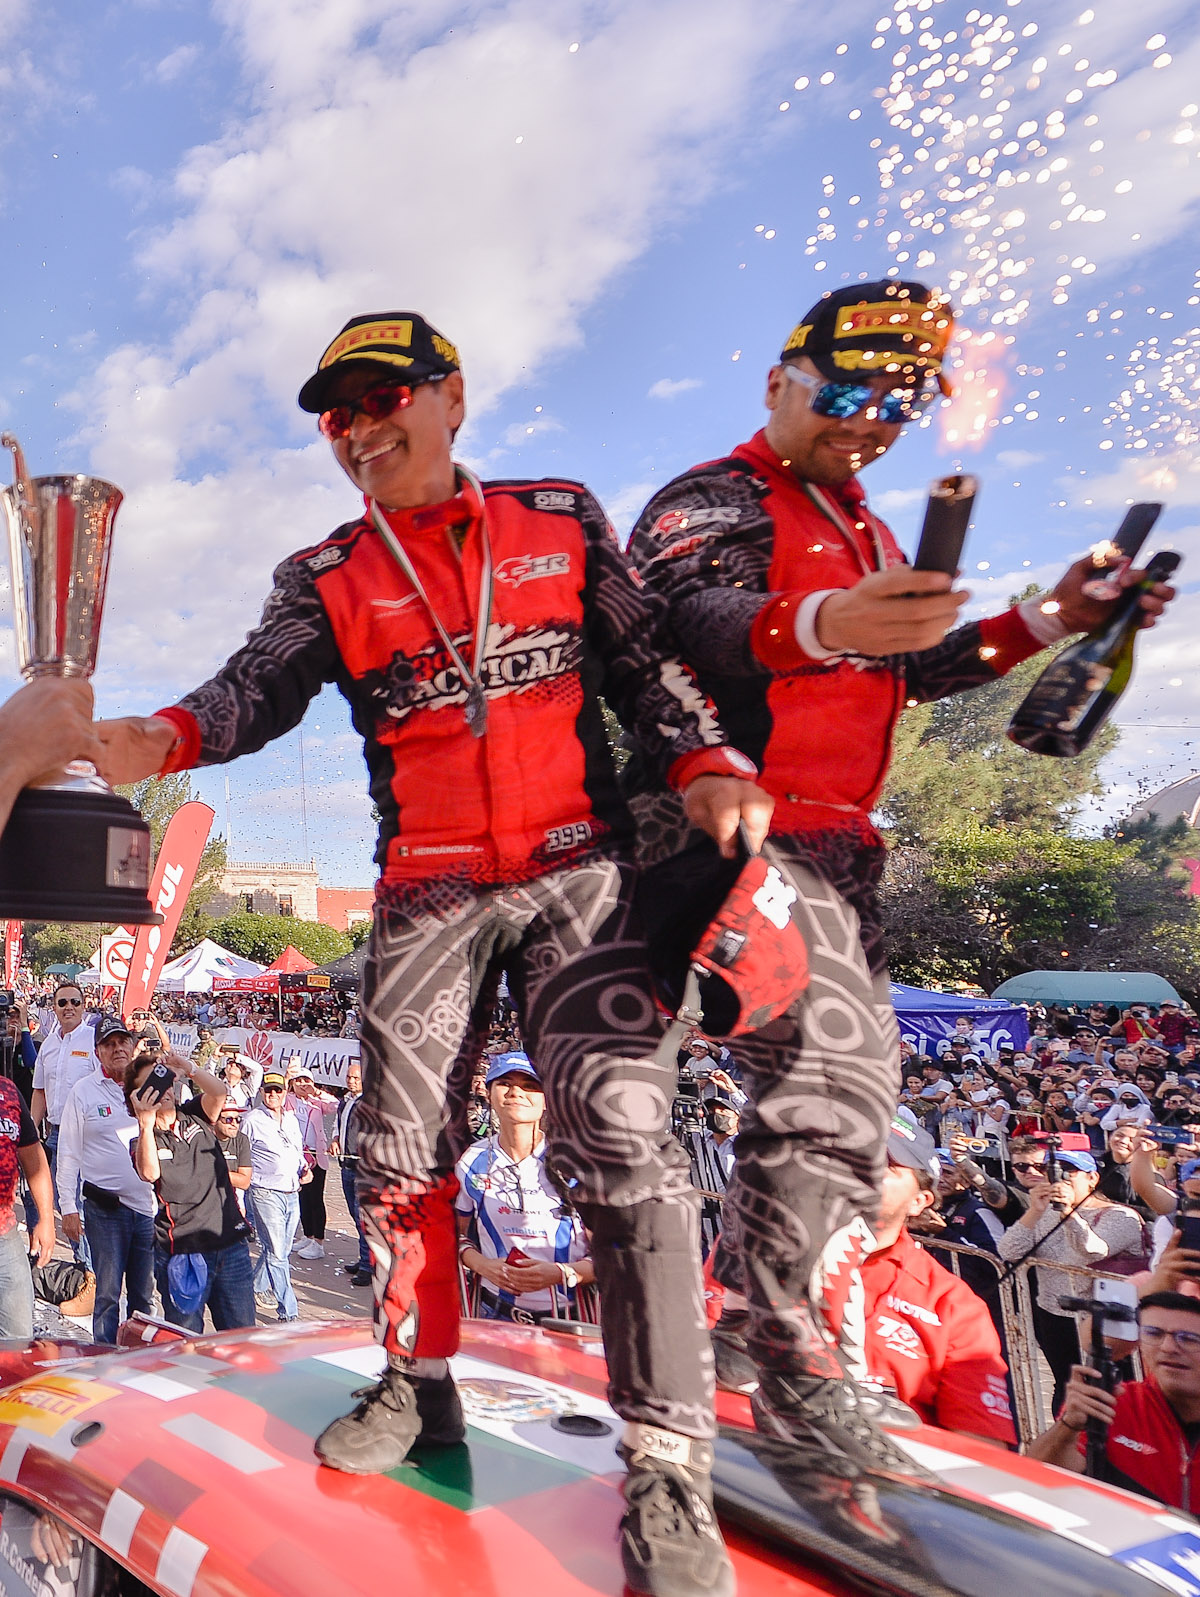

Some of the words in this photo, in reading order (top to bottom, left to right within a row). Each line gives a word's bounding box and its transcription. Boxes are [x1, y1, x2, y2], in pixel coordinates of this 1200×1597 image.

[535, 491, 576, 512] OMP
[308, 548, 342, 569] OMP
[546, 822, 592, 852] 399
[972, 1029, 1015, 1056] 5G
[0, 1385, 80, 1416] PIRELLI
